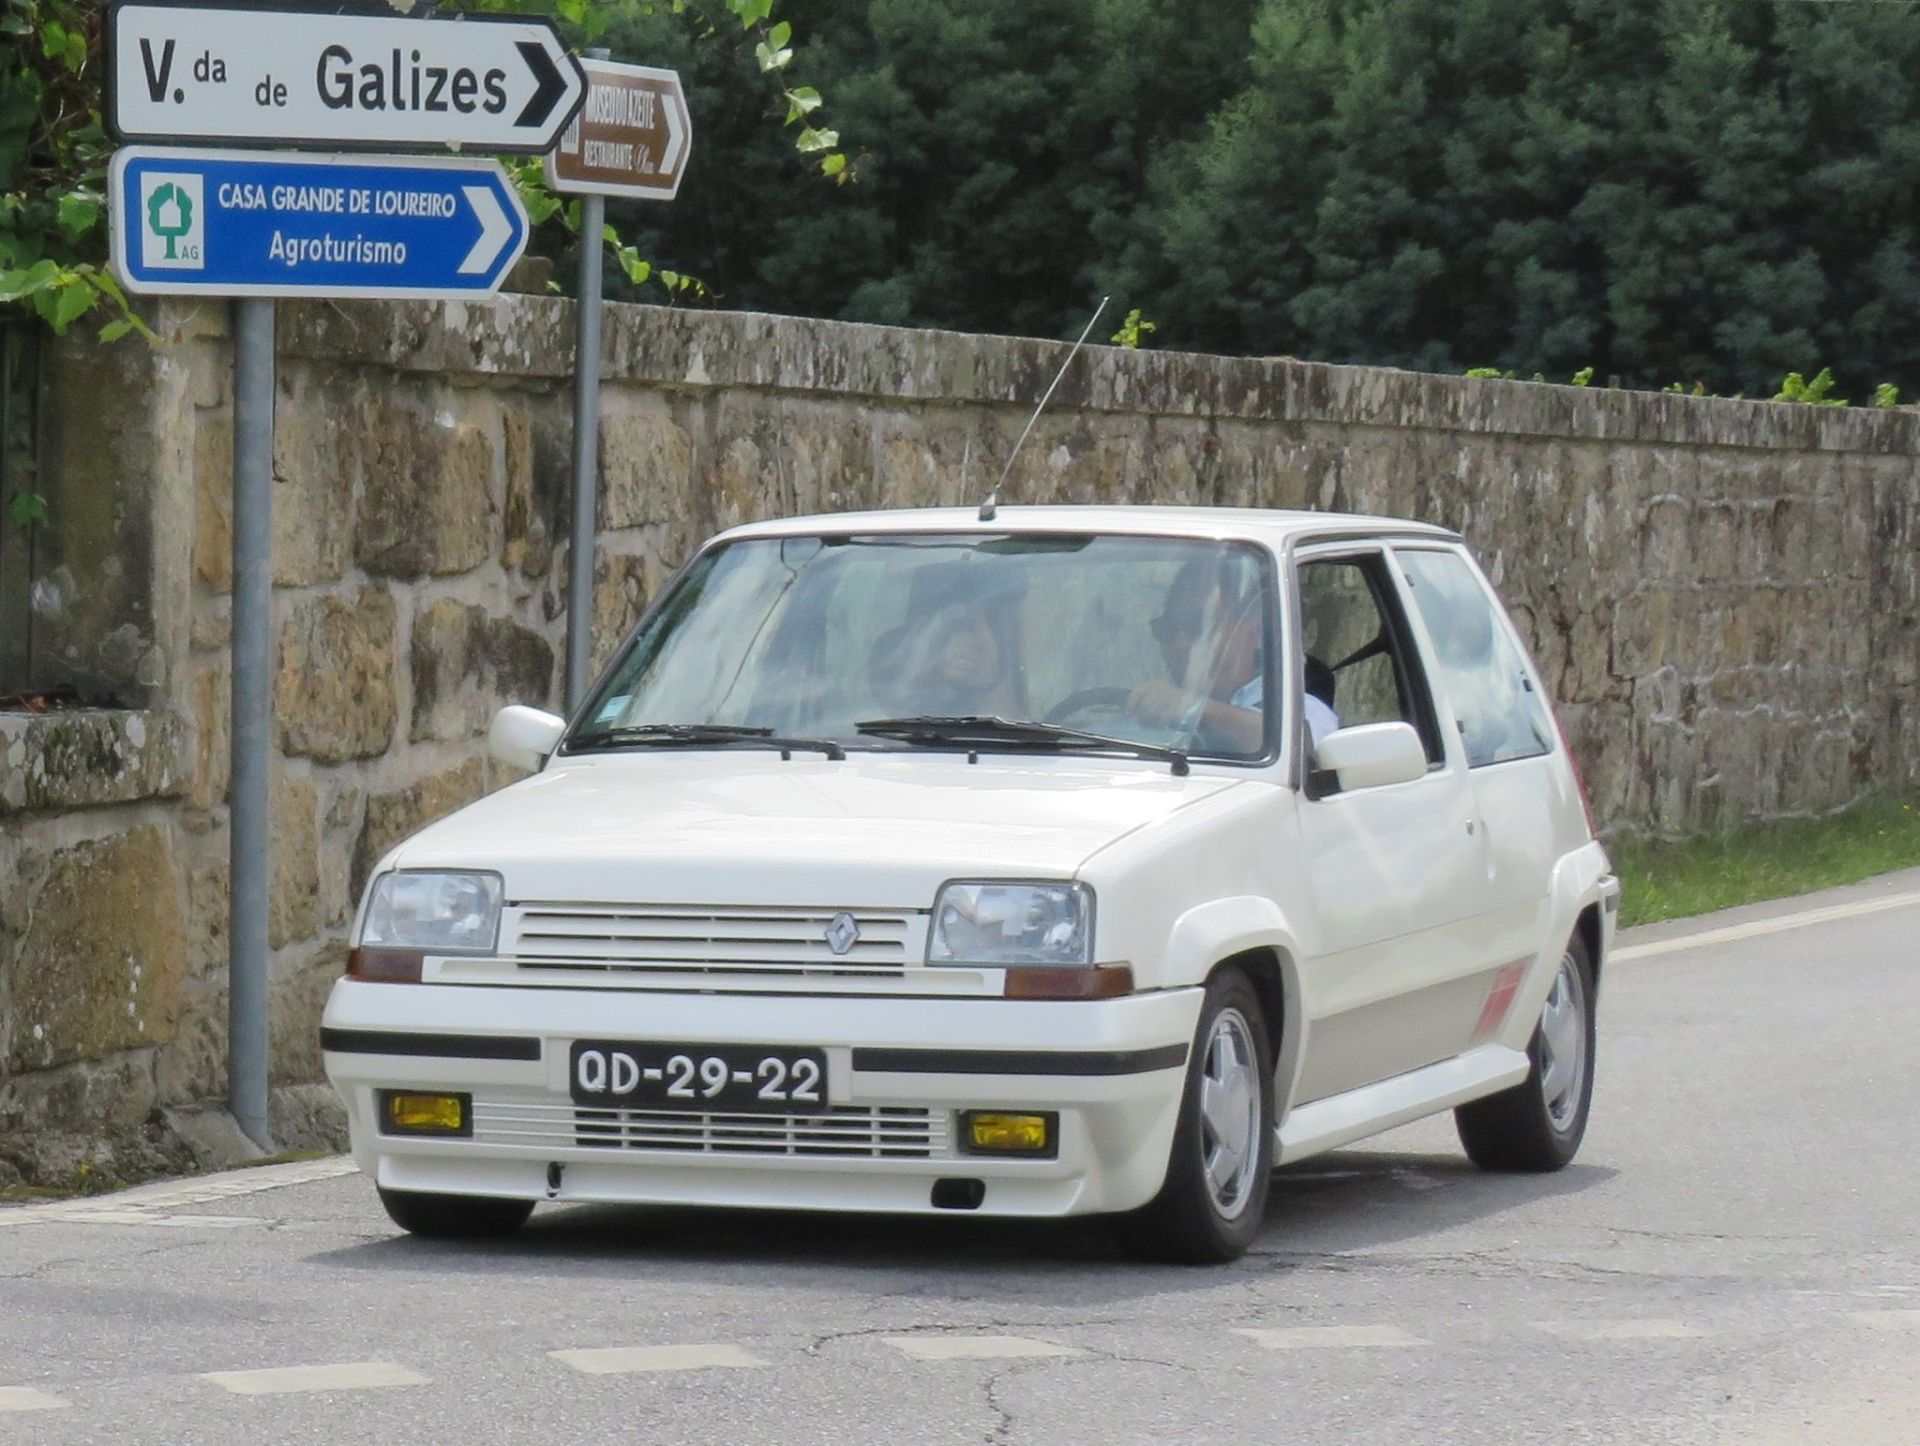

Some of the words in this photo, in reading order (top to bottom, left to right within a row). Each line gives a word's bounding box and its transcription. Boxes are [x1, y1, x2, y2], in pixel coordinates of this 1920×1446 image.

[139, 38, 184, 104] V.
[193, 50, 227, 83] da
[255, 74, 288, 107] de
[316, 44, 507, 114] Galizes
[628, 88, 655, 130] AZEITE
[584, 140, 633, 171] RESTAURANTE
[218, 183, 267, 209] CASA
[271, 185, 344, 212] GRANDE
[349, 189, 370, 214] DE
[375, 190, 456, 218] LOUREIRO
[181, 245, 199, 260] AG
[268, 230, 406, 267] Agroturismo
[578, 1050, 820, 1101] QD-29-22
